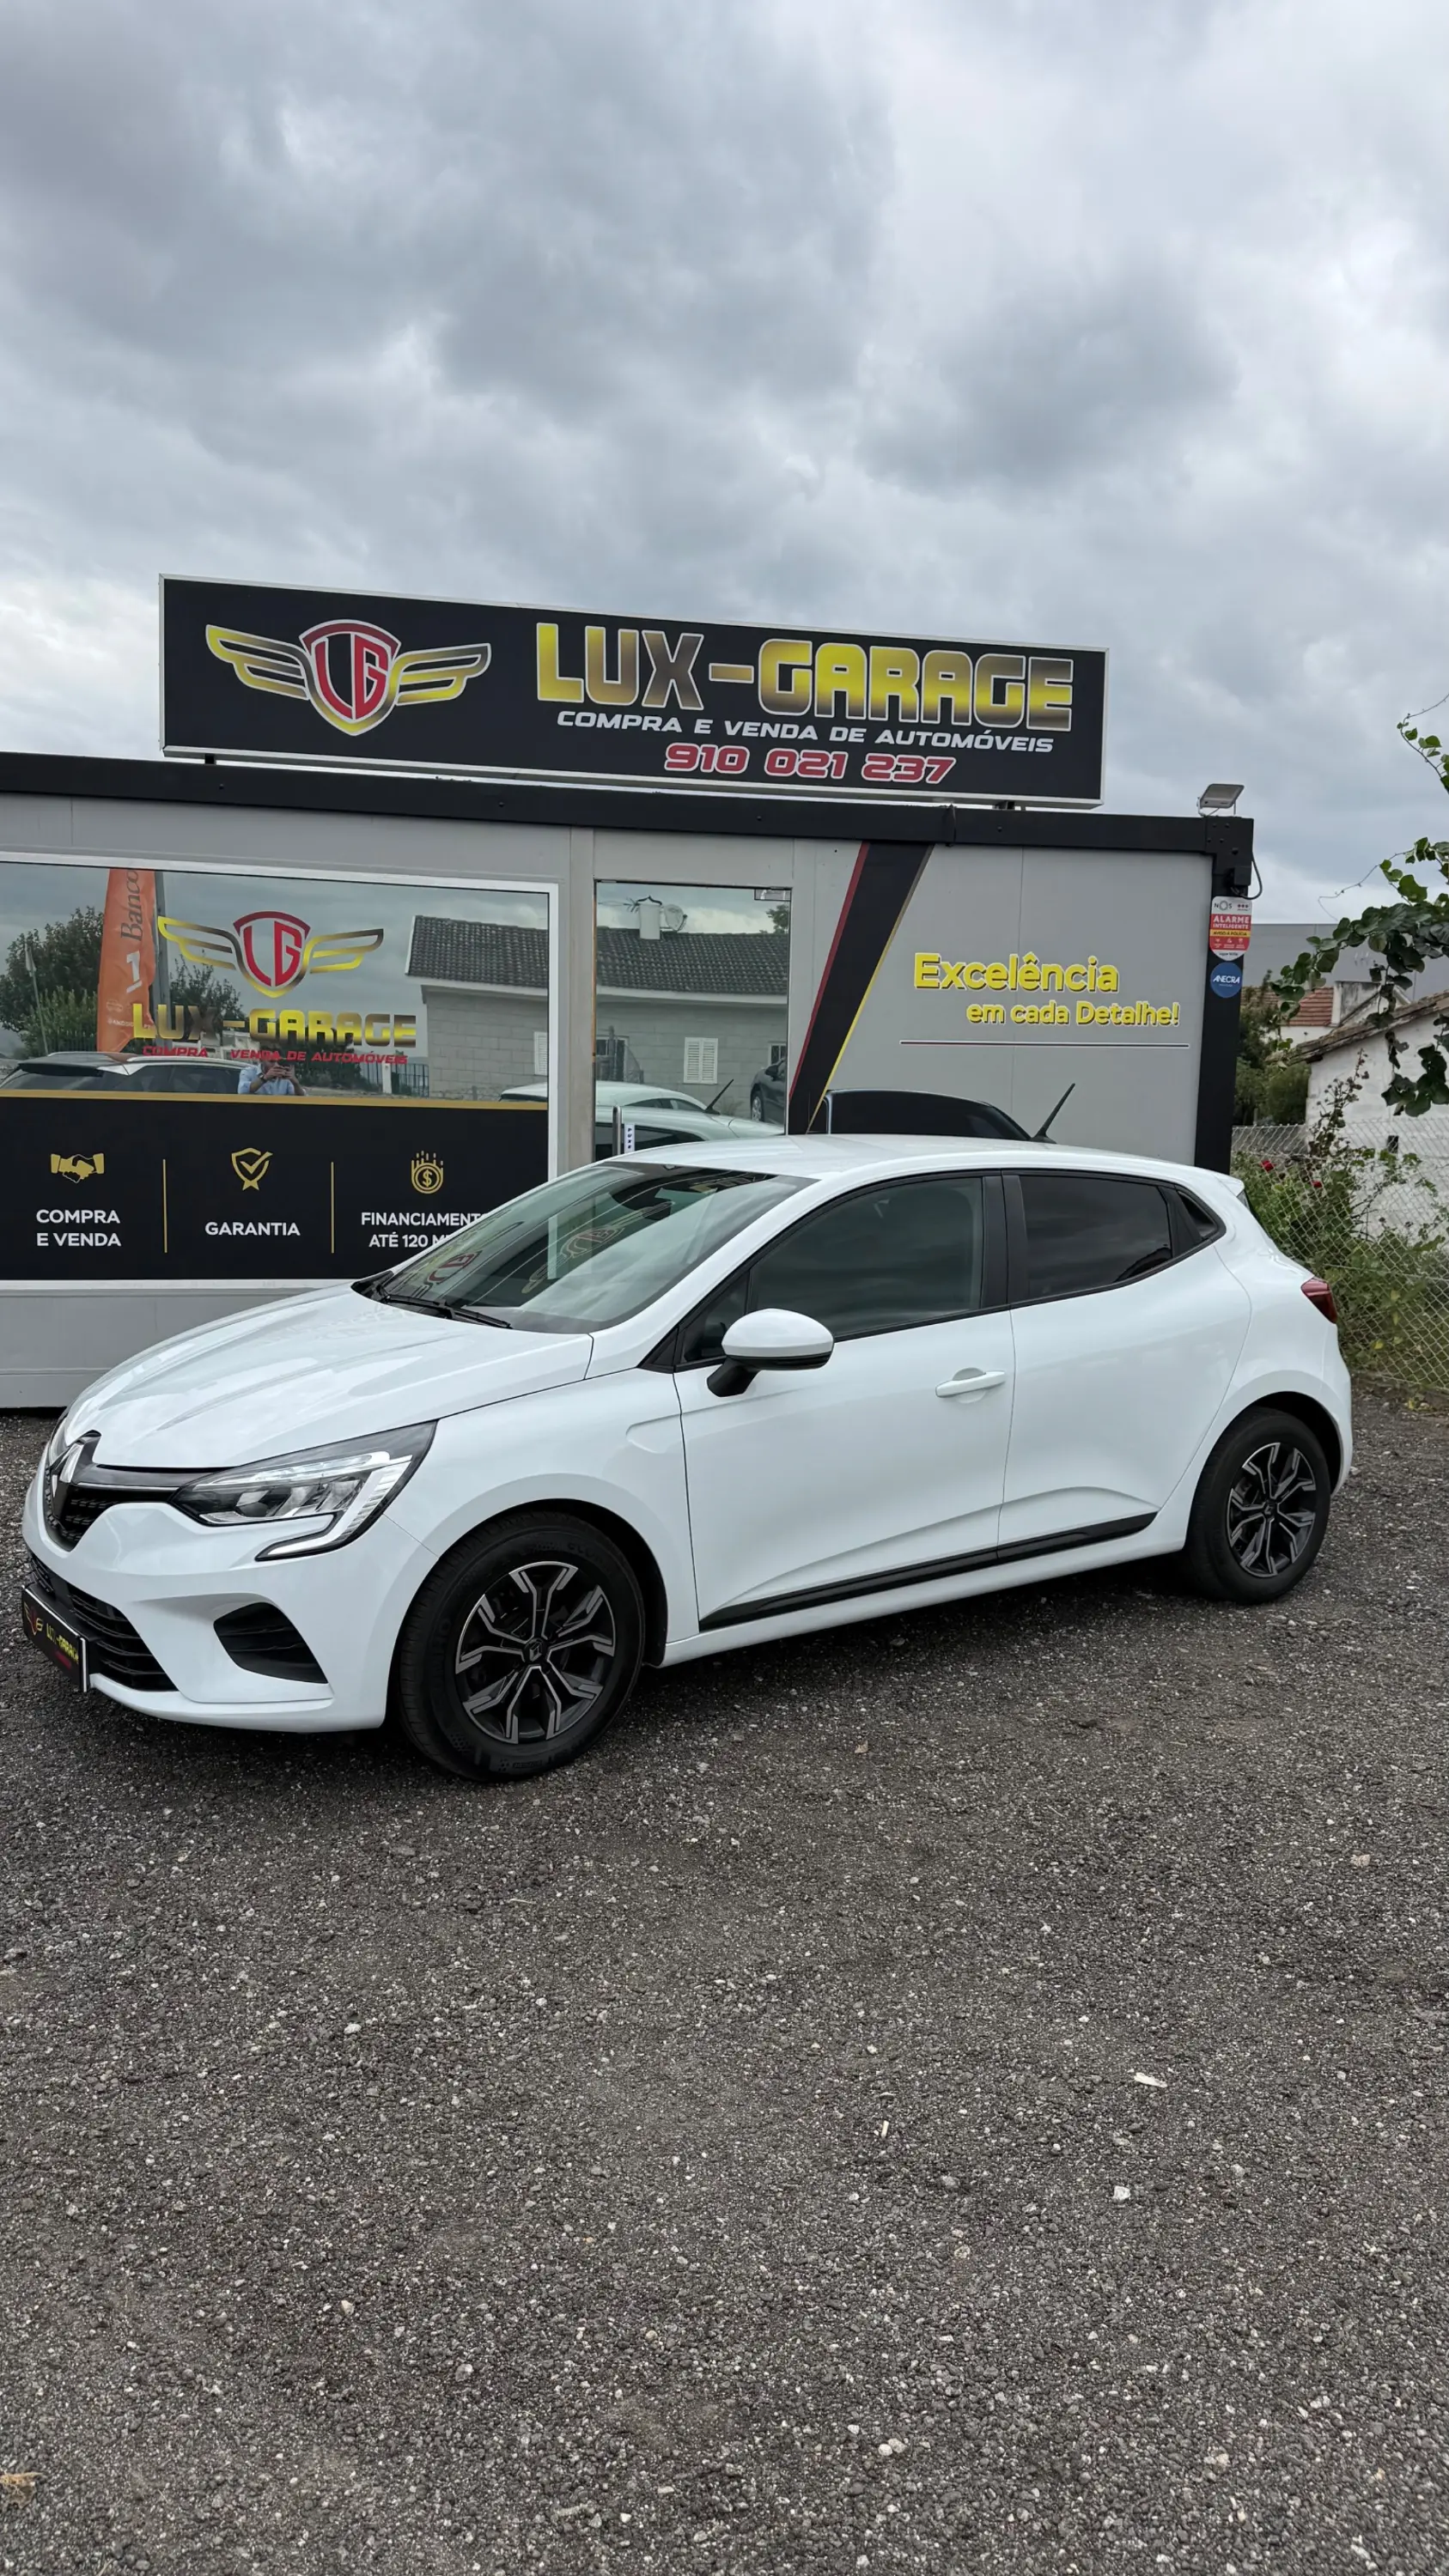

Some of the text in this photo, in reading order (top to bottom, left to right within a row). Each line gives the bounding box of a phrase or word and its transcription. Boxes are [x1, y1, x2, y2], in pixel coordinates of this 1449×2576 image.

[536, 622, 1074, 732] LUX-GARAGE
[557, 710, 1054, 752] COMPRA E VENDA DE AUTOMÓVEIS
[664, 743, 956, 784] 910 021 237
[1214, 900, 1233, 911] NOS
[1213, 915, 1250, 924] ALARME
[914, 951, 1119, 992] Excelência
[1213, 975, 1241, 984] ANECRA
[966, 999, 1181, 1027] em cada Detalhe!
[132, 1003, 417, 1048] LUX-GARAGE
[143, 1045, 408, 1065] COMPRA VENDA DE AUTOMÓVEIS
[36, 1209, 121, 1224] COMPRA
[361, 1212, 488, 1226] FINANCIAMENT
[204, 1221, 301, 1236] GARANTIA
[36, 1232, 122, 1247] E VENDA
[368, 1231, 399, 1248] ATÉ
[402, 1234, 429, 1248] 120
